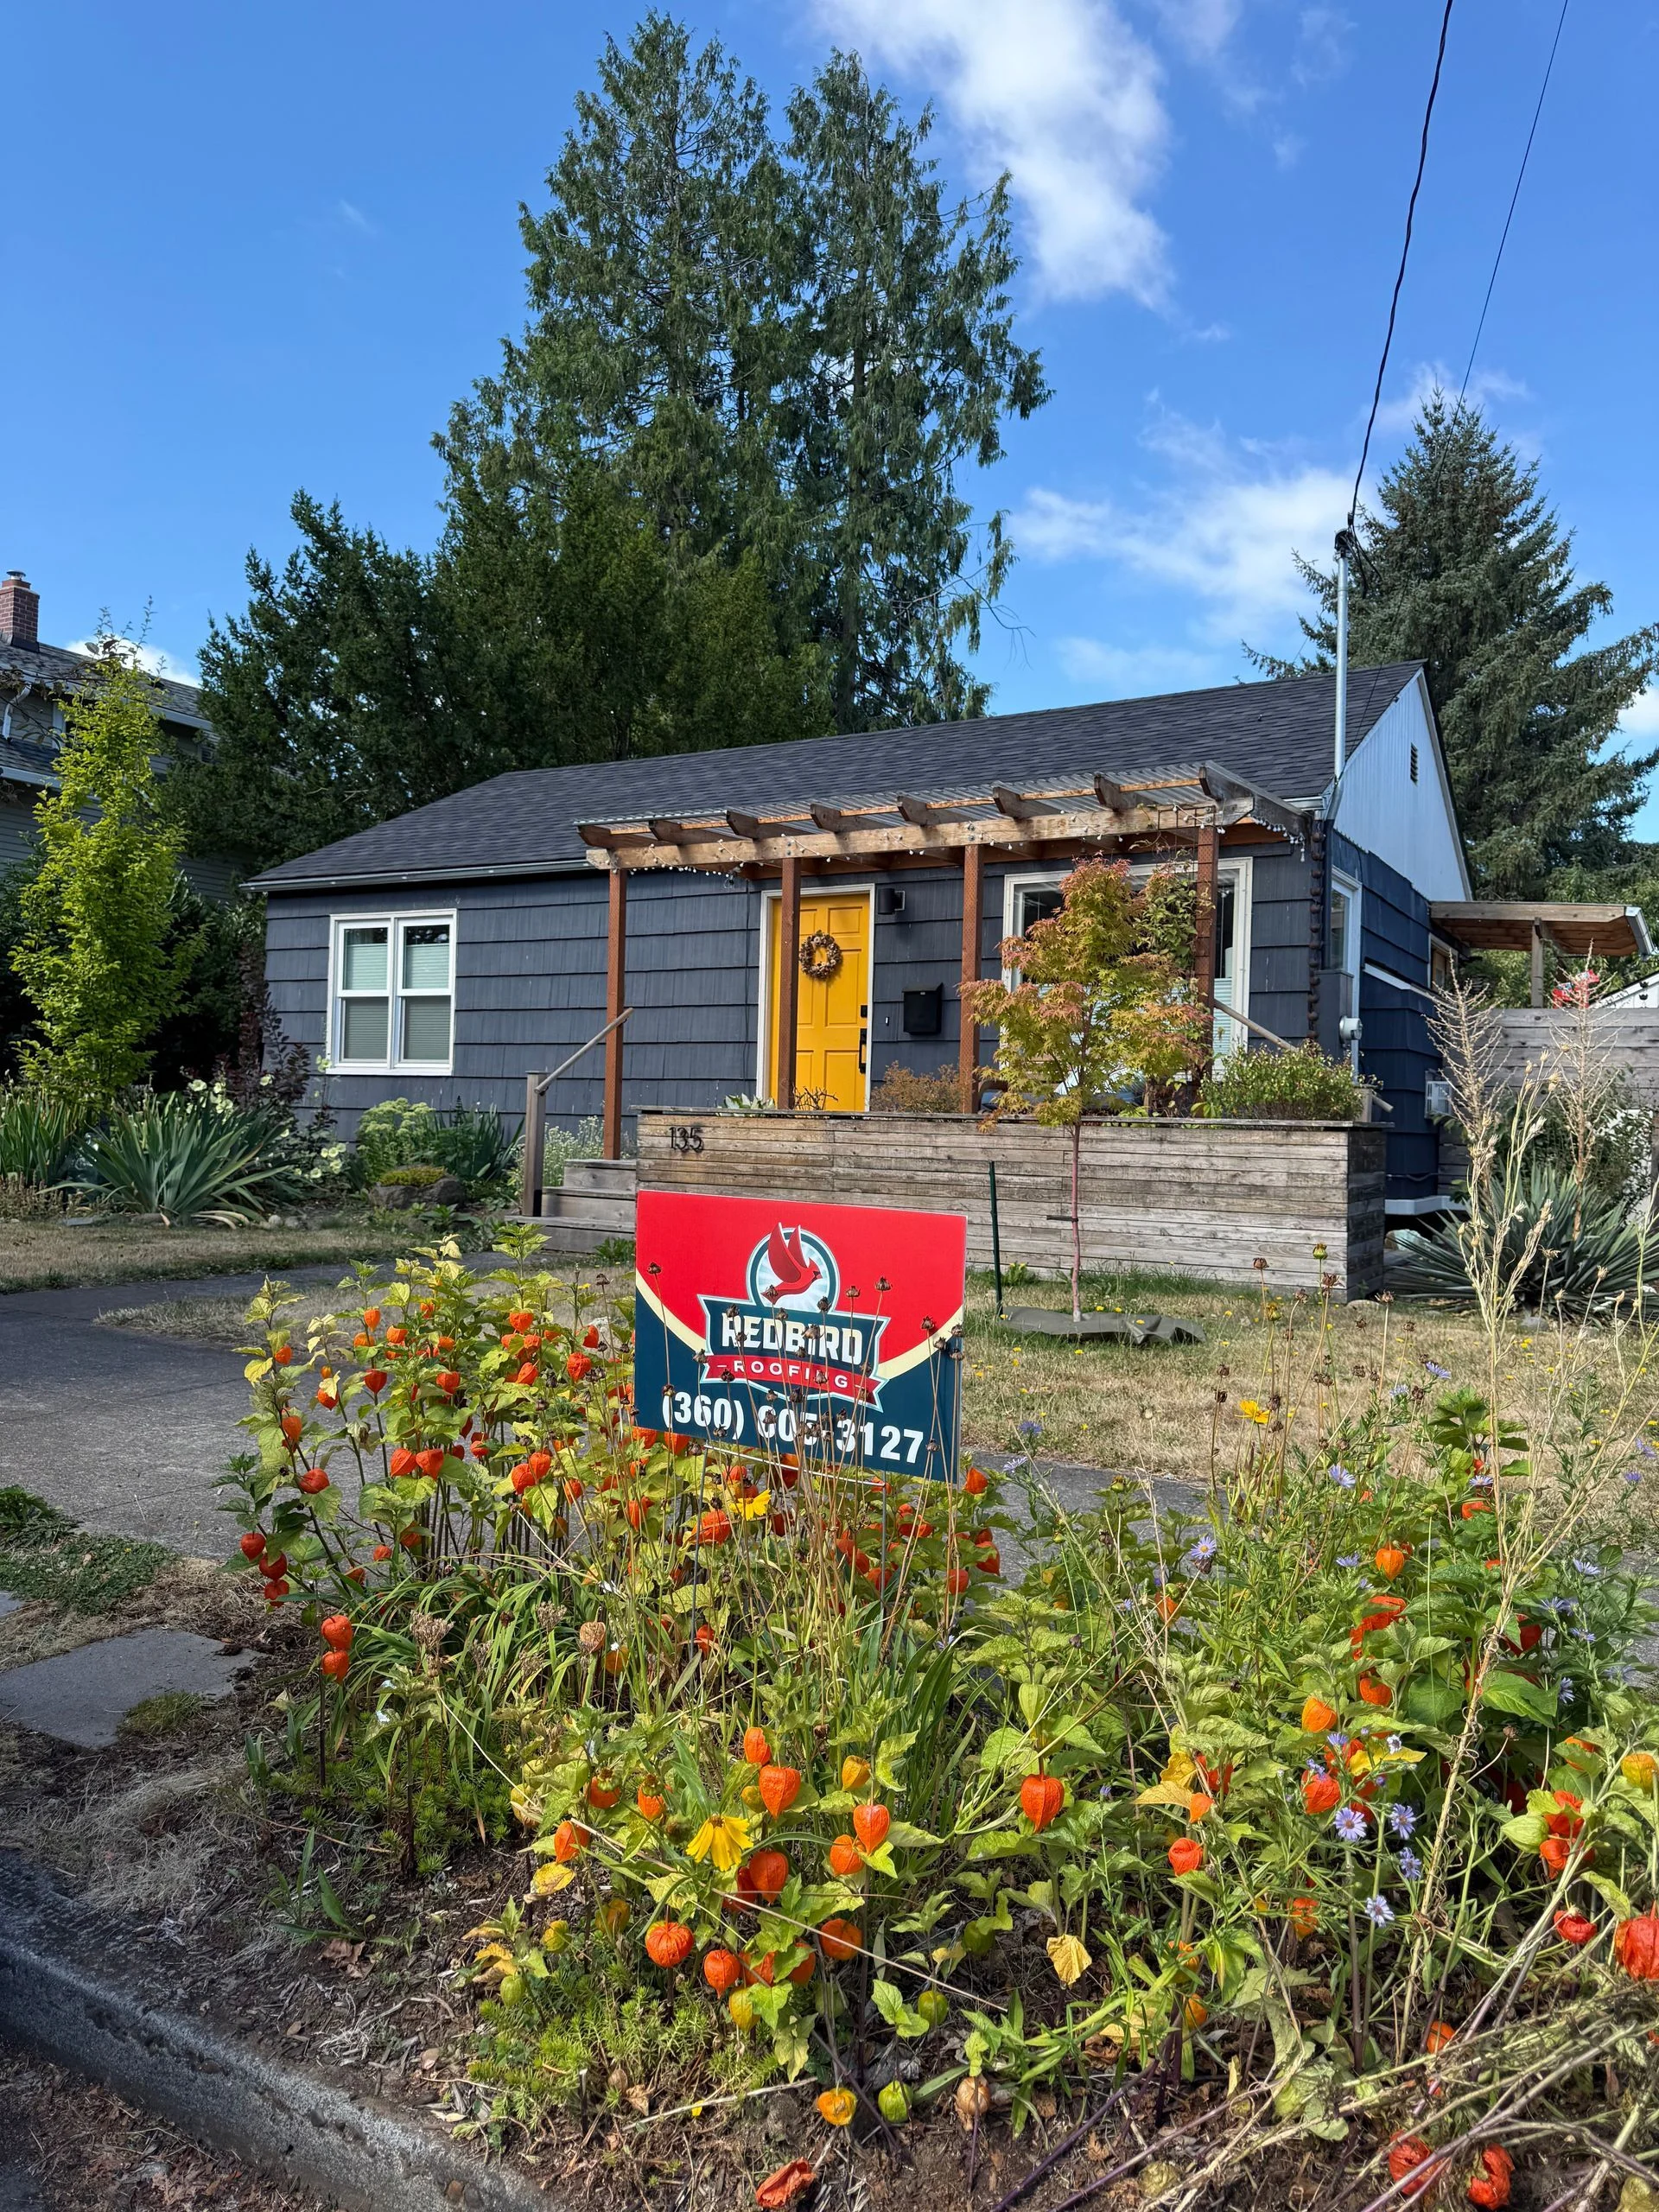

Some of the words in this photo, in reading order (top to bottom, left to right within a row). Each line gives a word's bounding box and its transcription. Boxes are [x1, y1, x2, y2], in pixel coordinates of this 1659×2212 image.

[669, 1127, 702, 1150] 135
[721, 1313, 862, 1365] REDBIRD
[662, 1392, 745, 1440] (360)
